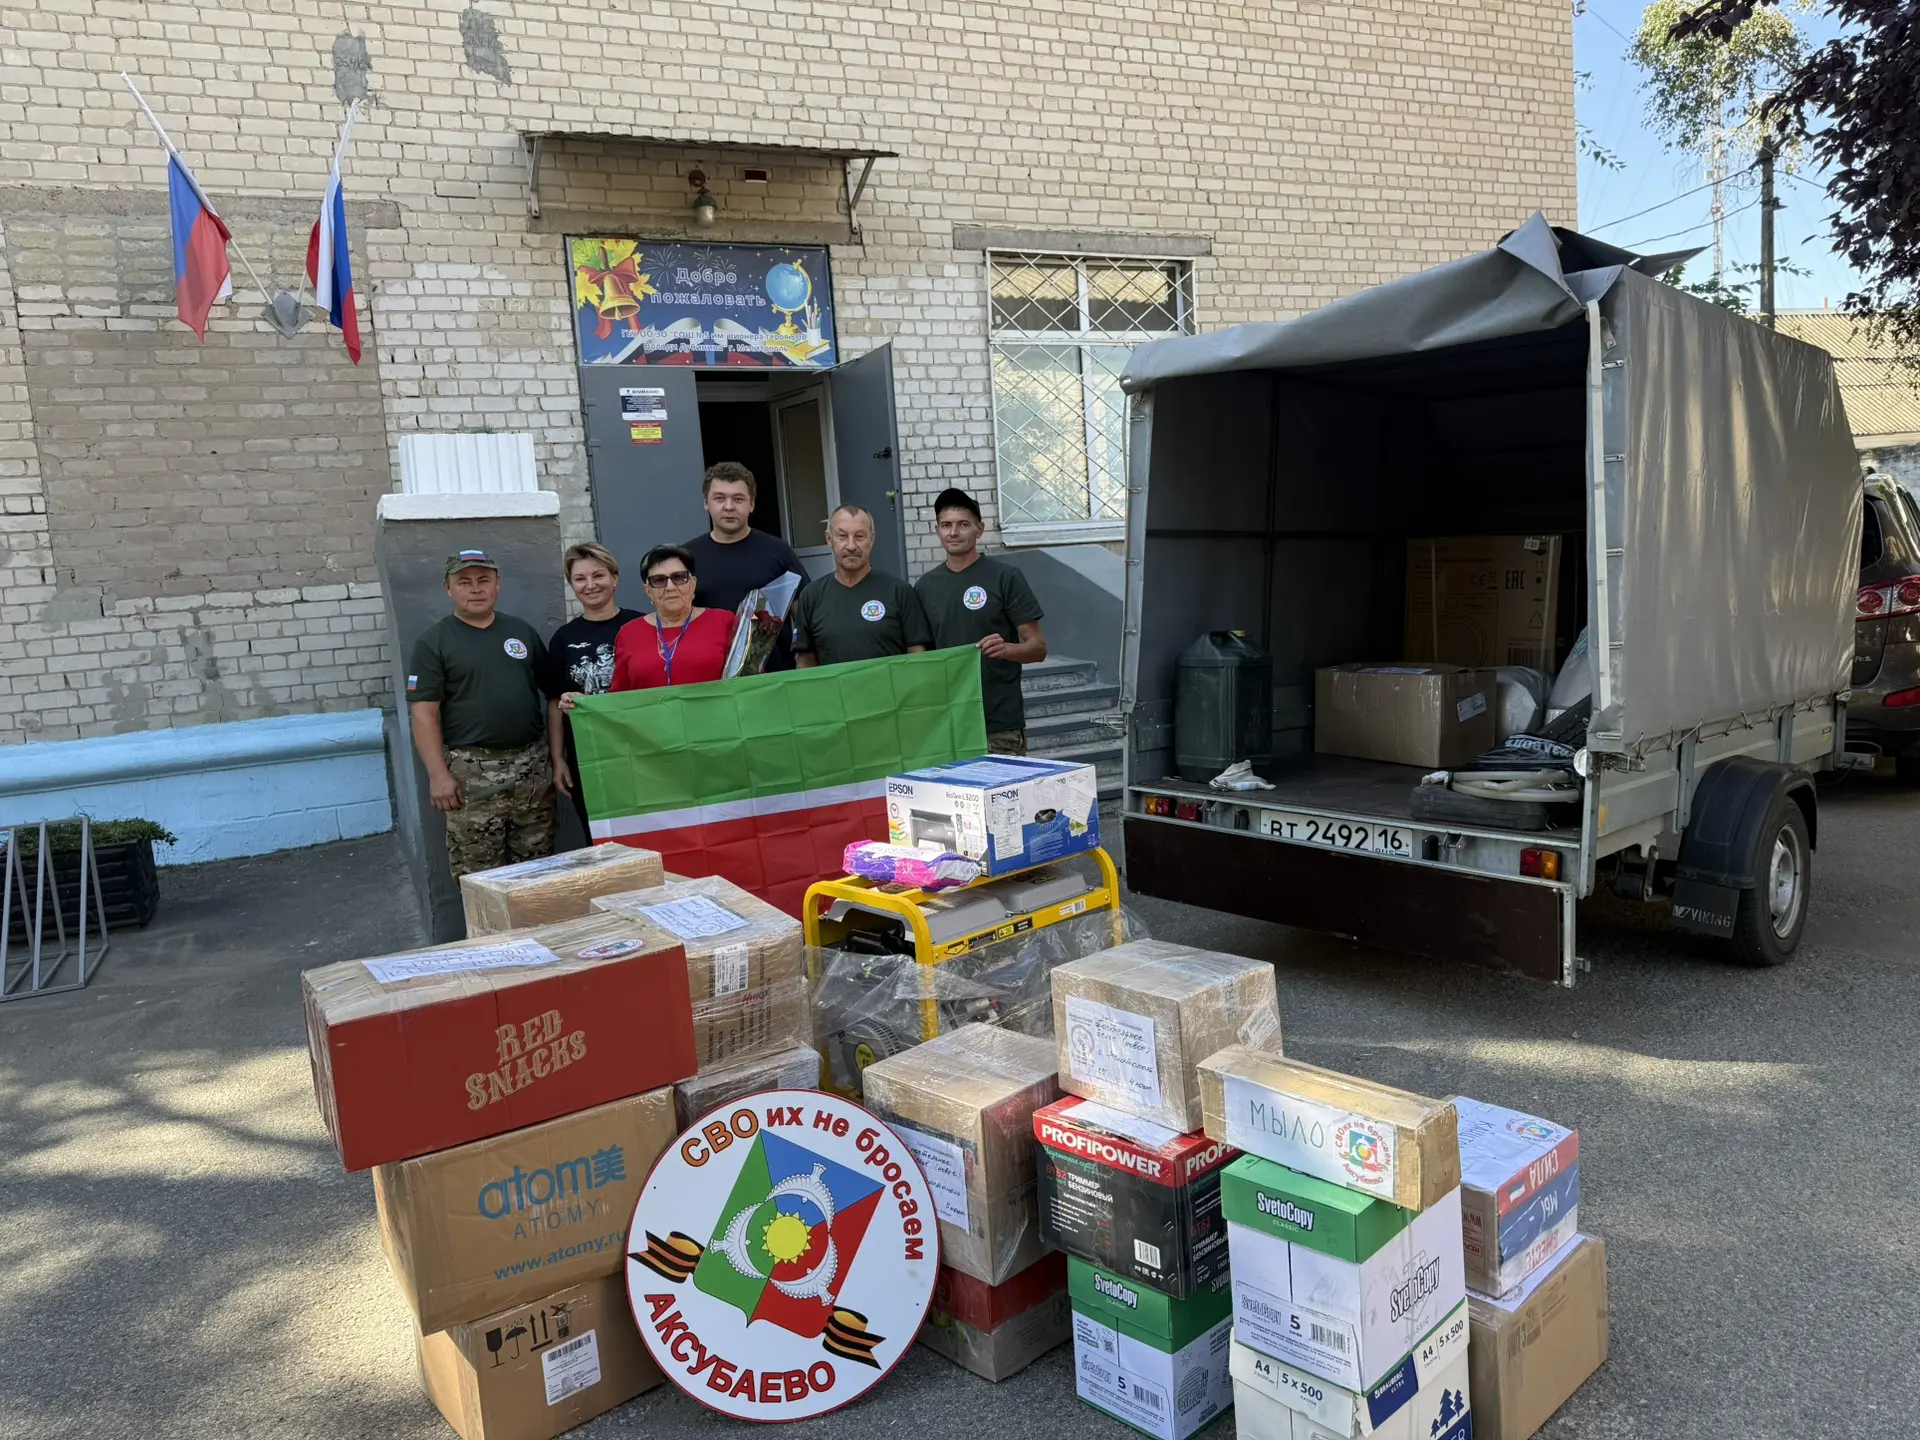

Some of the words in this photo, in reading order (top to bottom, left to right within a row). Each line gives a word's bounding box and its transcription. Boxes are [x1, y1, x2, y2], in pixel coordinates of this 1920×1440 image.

[675, 267, 738, 286] Добро
[650, 291, 767, 308] пожаловать
[737, 343, 789, 353] Мелитополь
[1505, 570, 1527, 590] EAC
[888, 782, 914, 796] EPSON
[1306, 820, 1370, 851] 2492
[1377, 828, 1403, 850] 16
[1691, 908, 1731, 928] VIKING
[495, 1009, 563, 1067] RED
[465, 1030, 587, 1111] SNACKS
[1250, 1099, 1324, 1149] МЫЛО
[1041, 1123, 1161, 1178] PROFIPOWER
[1067, 1172, 1100, 1190] ТРИММЕР
[1529, 1148, 1560, 1190] СИЛА
[812, 1110, 850, 1138] не
[855, 1127, 924, 1261] бросаем
[1067, 1181, 1114, 1203] БЕНЗИНОВЫЙ
[514, 1199, 600, 1241] ATOMY
[1256, 1190, 1315, 1232] SvetoCopy
[1540, 1190, 1558, 1222] МЫ
[1272, 1219, 1300, 1233] CLASSIC
[494, 1230, 628, 1280] www.atomy.ru
[1192, 1231, 1219, 1254] ТРИММЕР
[1095, 1273, 1139, 1309] SvetoCopy
[1391, 1256, 1440, 1323] SvetoCopy
[1241, 1294, 1282, 1325] SvetoCopy
[1290, 1314, 1301, 1330] 5
[1403, 1316, 1430, 1344] CLASSIC
[1439, 1336, 1445, 1348] 5
[1450, 1320, 1464, 1337] 500
[644, 1293, 836, 1403] АКСУБАЕВО
[1422, 1346, 1434, 1362] A4
[1255, 1359, 1270, 1375] A4
[1117, 1376, 1126, 1389] 5
[1281, 1373, 1289, 1384] 5
[1300, 1381, 1323, 1401] 500
[1379, 1370, 1404, 1397] BRAUBERG
[1390, 1379, 1405, 1394] ULTRA
